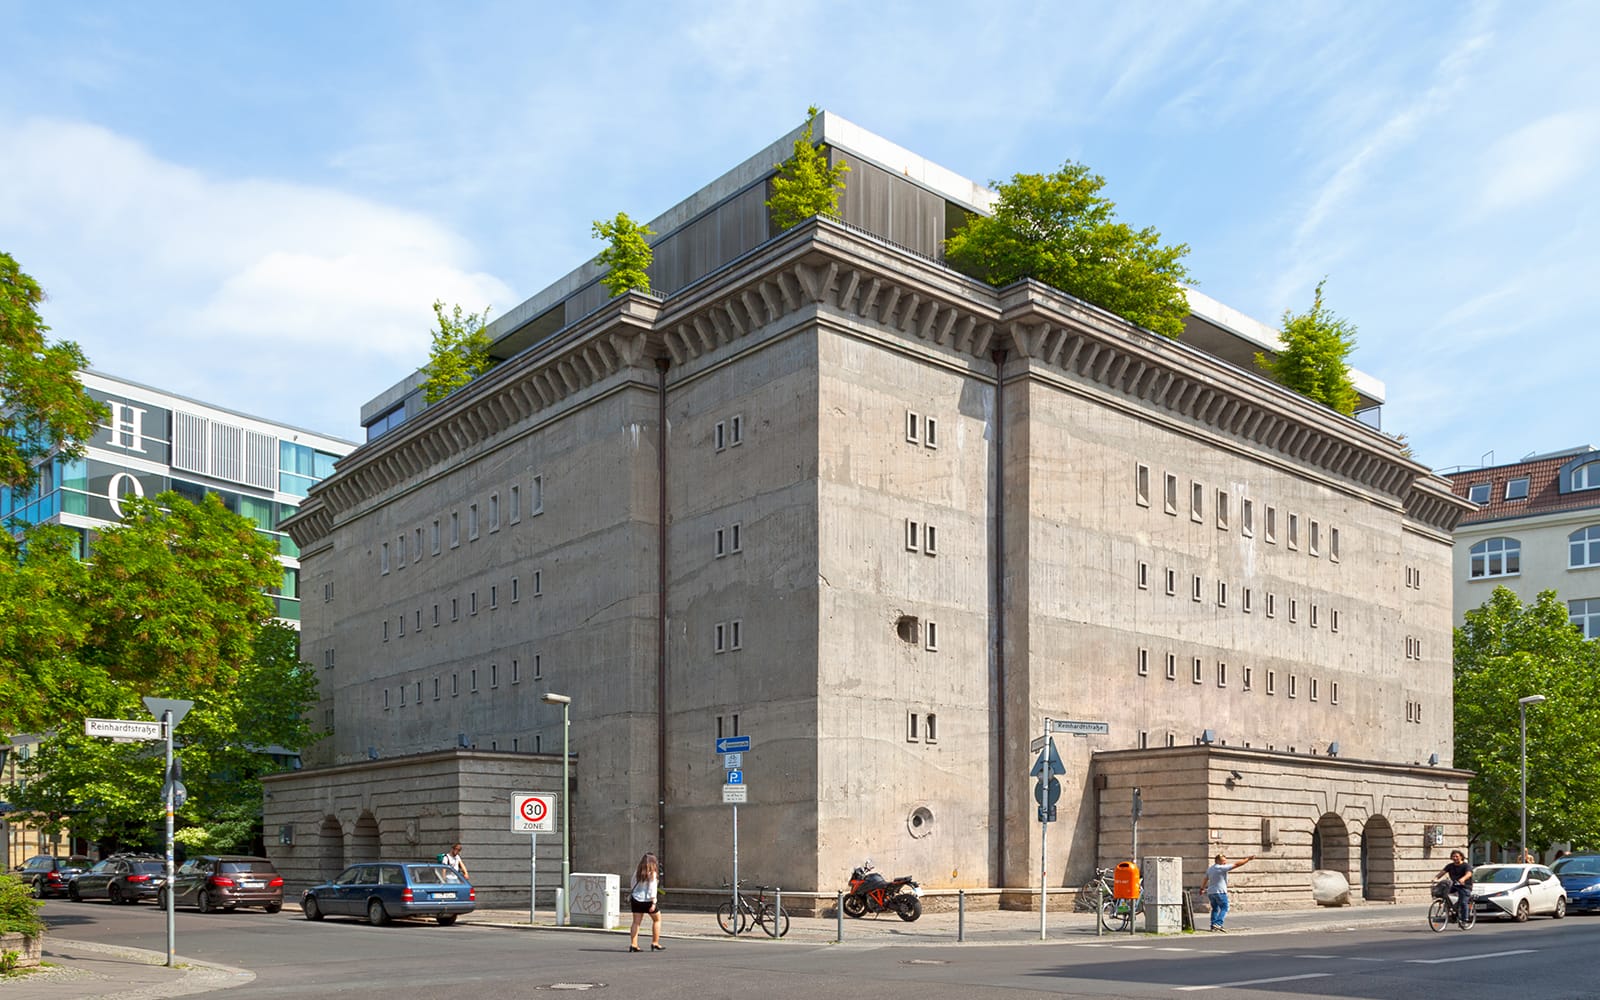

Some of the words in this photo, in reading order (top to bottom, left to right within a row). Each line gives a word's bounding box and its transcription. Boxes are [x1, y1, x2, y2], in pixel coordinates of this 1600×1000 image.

[91, 721, 156, 735] Reinhardtstraße
[526, 804, 542, 816] 30
[523, 822, 544, 830] ZONE
